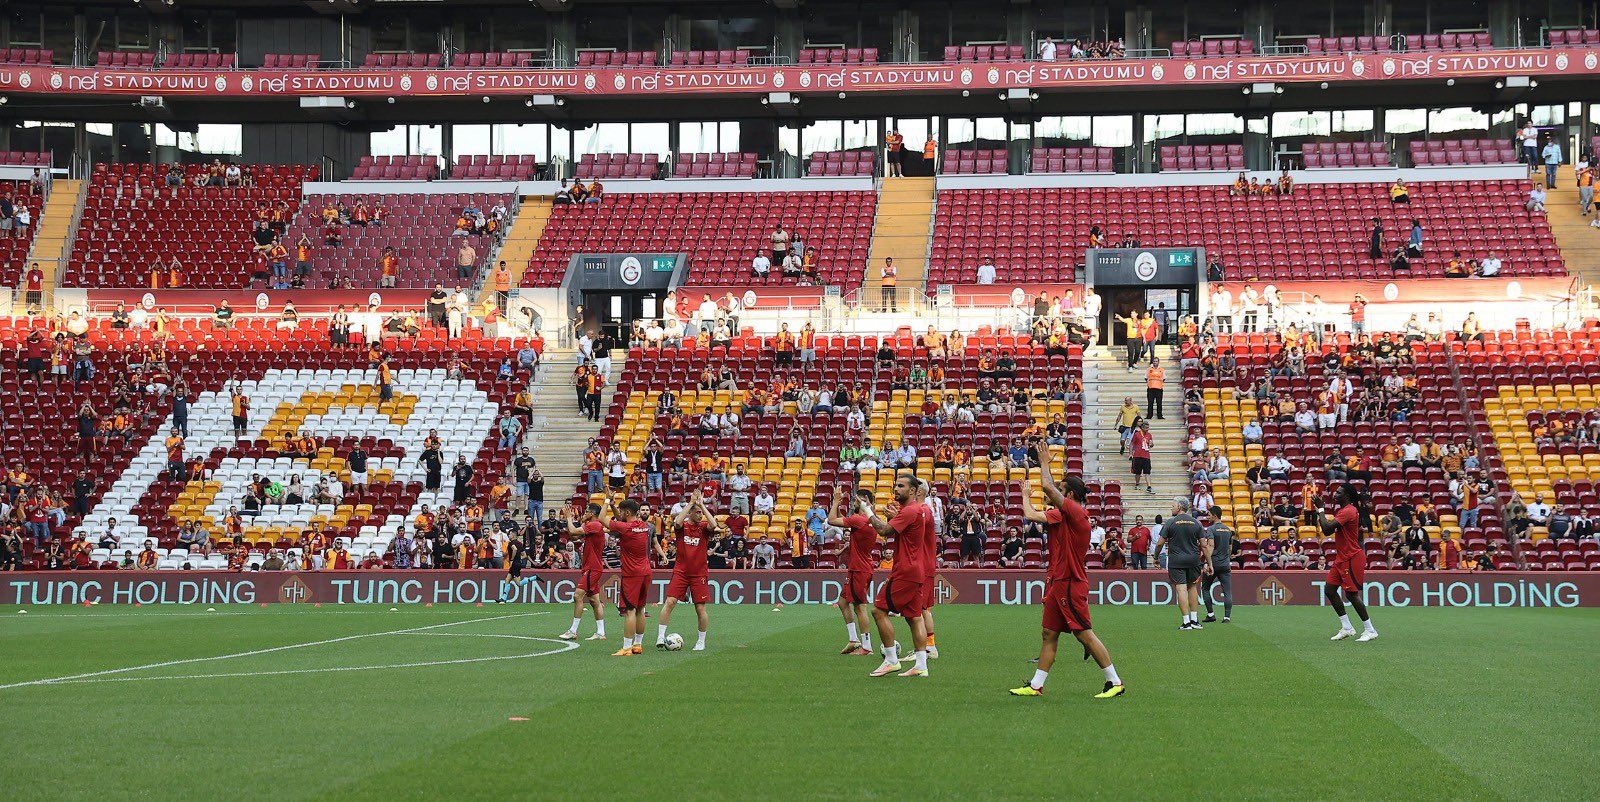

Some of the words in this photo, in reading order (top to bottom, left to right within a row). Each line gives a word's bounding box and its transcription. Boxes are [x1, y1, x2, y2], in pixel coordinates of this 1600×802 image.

[1006, 66, 1036, 84] nef
[1039, 65, 1145, 82] STADYUMU
[1202, 61, 1233, 80] nef
[1237, 60, 1346, 76] STADYUMU
[1402, 56, 1434, 76] nef
[1437, 54, 1548, 71] STADYUMU
[70, 72, 98, 90] nef
[103, 75, 208, 89] STADYUMU
[259, 73, 288, 91] nef
[292, 75, 394, 89] STADYUMU
[444, 72, 472, 91] nef
[476, 73, 577, 88] STADYUMU
[632, 71, 660, 90] nef
[664, 72, 766, 86] STADYUMU
[818, 69, 847, 87] nef
[851, 68, 954, 84] STADYUMU
